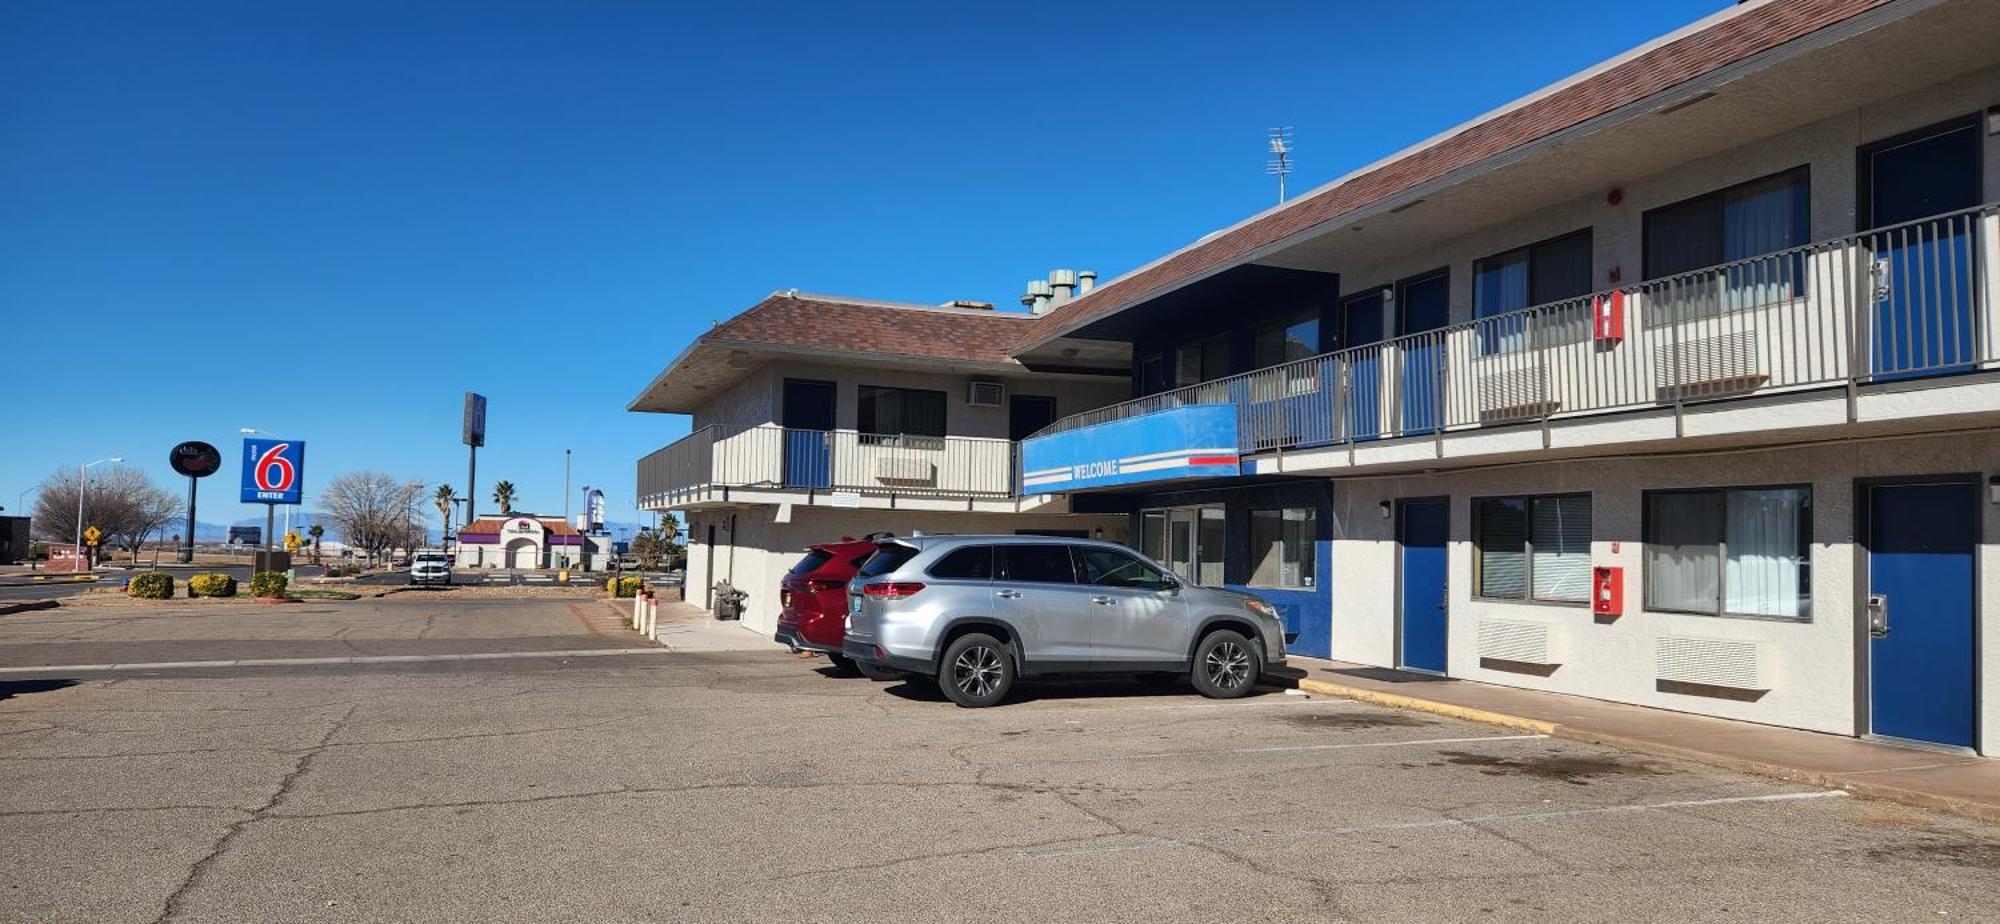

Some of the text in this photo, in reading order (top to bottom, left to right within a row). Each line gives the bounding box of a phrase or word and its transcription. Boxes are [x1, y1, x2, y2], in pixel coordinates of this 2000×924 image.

[255, 444, 294, 491] 6
[1073, 460, 1118, 480] WELCOME
[257, 491, 284, 499] ENTER
